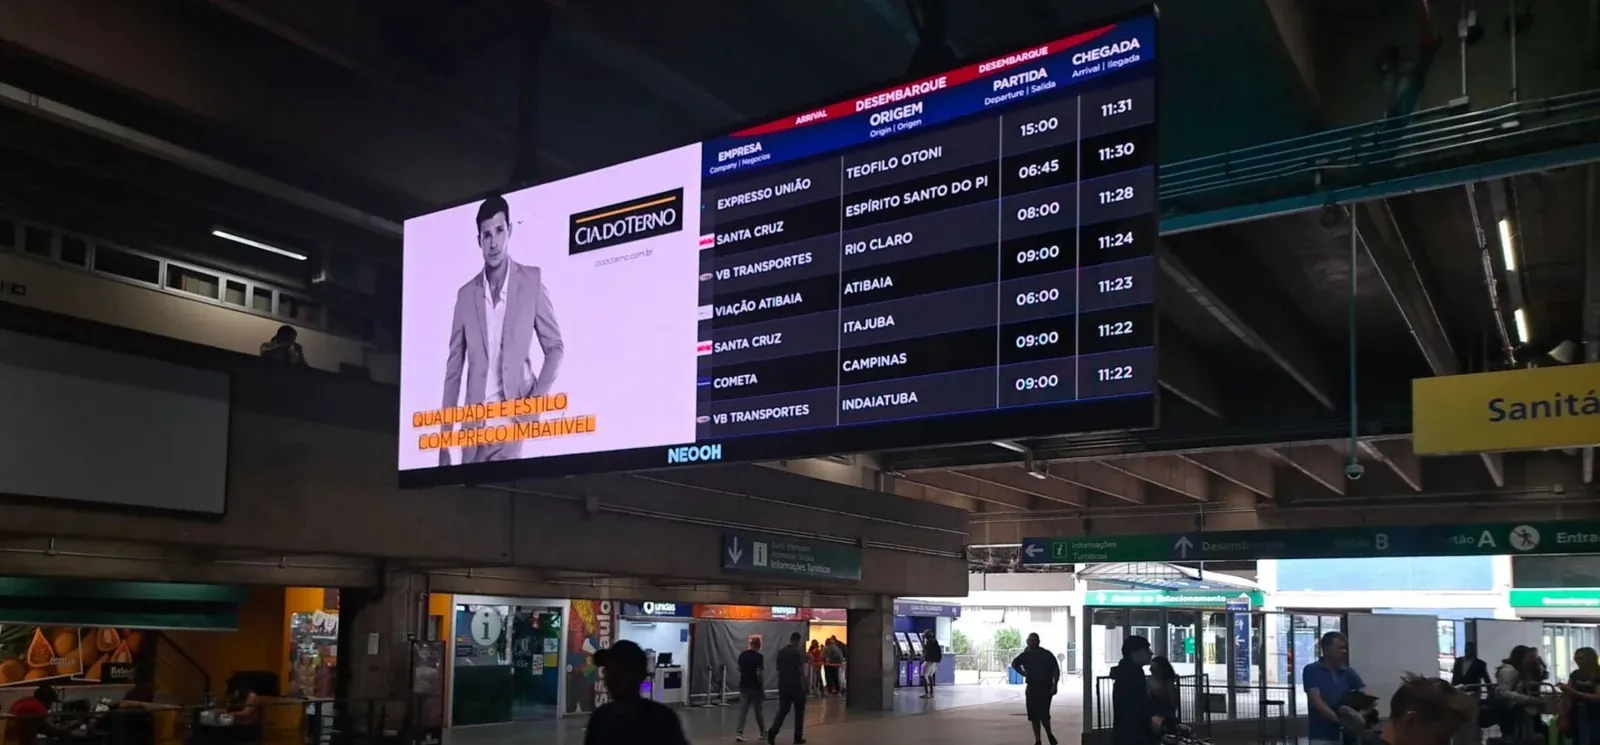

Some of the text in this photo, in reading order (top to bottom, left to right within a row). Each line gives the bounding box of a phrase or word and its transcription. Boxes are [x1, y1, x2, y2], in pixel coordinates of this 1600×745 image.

[979, 46, 1048, 73] DESEMBARQUE
[1072, 38, 1140, 65] CHEGADA
[993, 67, 1048, 91] PARTIDA
[1072, 64, 1100, 78] Arrival
[796, 76, 947, 125] ARRIVAL DESEMBARQUE
[984, 80, 1056, 106] Departure Salida
[870, 102, 923, 126] ORIGEM
[1100, 99, 1133, 118] 11:31
[870, 119, 921, 138] Origin Origen
[1020, 117, 1058, 138] 15:00
[718, 142, 762, 162] EMPRESA
[1098, 142, 1135, 161] 11:30
[709, 153, 771, 174] Company Negocios
[846, 146, 942, 179] TEOFILO OTONI
[1018, 158, 1059, 179] 06:45
[717, 178, 811, 210] EXPRESSO UNIÃO
[846, 176, 988, 217] ESPÍRITO SANTO DO PI
[1098, 186, 1134, 205] 11:28
[1016, 201, 1060, 221] 08:00
[716, 226, 750, 246] SANTA
[752, 221, 784, 239] CRUZ
[845, 232, 913, 255] RIO CLARO
[1098, 231, 1134, 250] 11:24
[1016, 244, 1059, 264] 09:00
[716, 253, 812, 280] VB TRANSPORTES
[844, 276, 893, 294] ATIBAIA
[1098, 276, 1133, 294] 11:23
[715, 293, 803, 317] VIAÇÃO ATIBAIA
[1016, 288, 1059, 307] 06:00
[843, 315, 895, 333] ITAJUBA
[1098, 320, 1133, 337] 11:22
[714, 337, 749, 353] SANTA
[752, 333, 782, 349] CRUZ
[1015, 331, 1059, 349] 09:00
[842, 352, 907, 372] CAMPINAS
[714, 373, 758, 389] COMETA
[1015, 374, 1058, 391] 09:00
[1098, 365, 1133, 382] 11:22
[412, 392, 568, 427] QUALIDADE E ESTILO
[842, 391, 918, 411] INDAIATUBA
[713, 404, 810, 424] VB TRANSPORTES
[418, 432, 452, 450] COM
[513, 413, 596, 440] IMBATÍVEL
[668, 444, 721, 464] NEOOH
[1375, 533, 1389, 550] B
[1477, 530, 1496, 548] A
[1556, 532, 1600, 544] Entra
